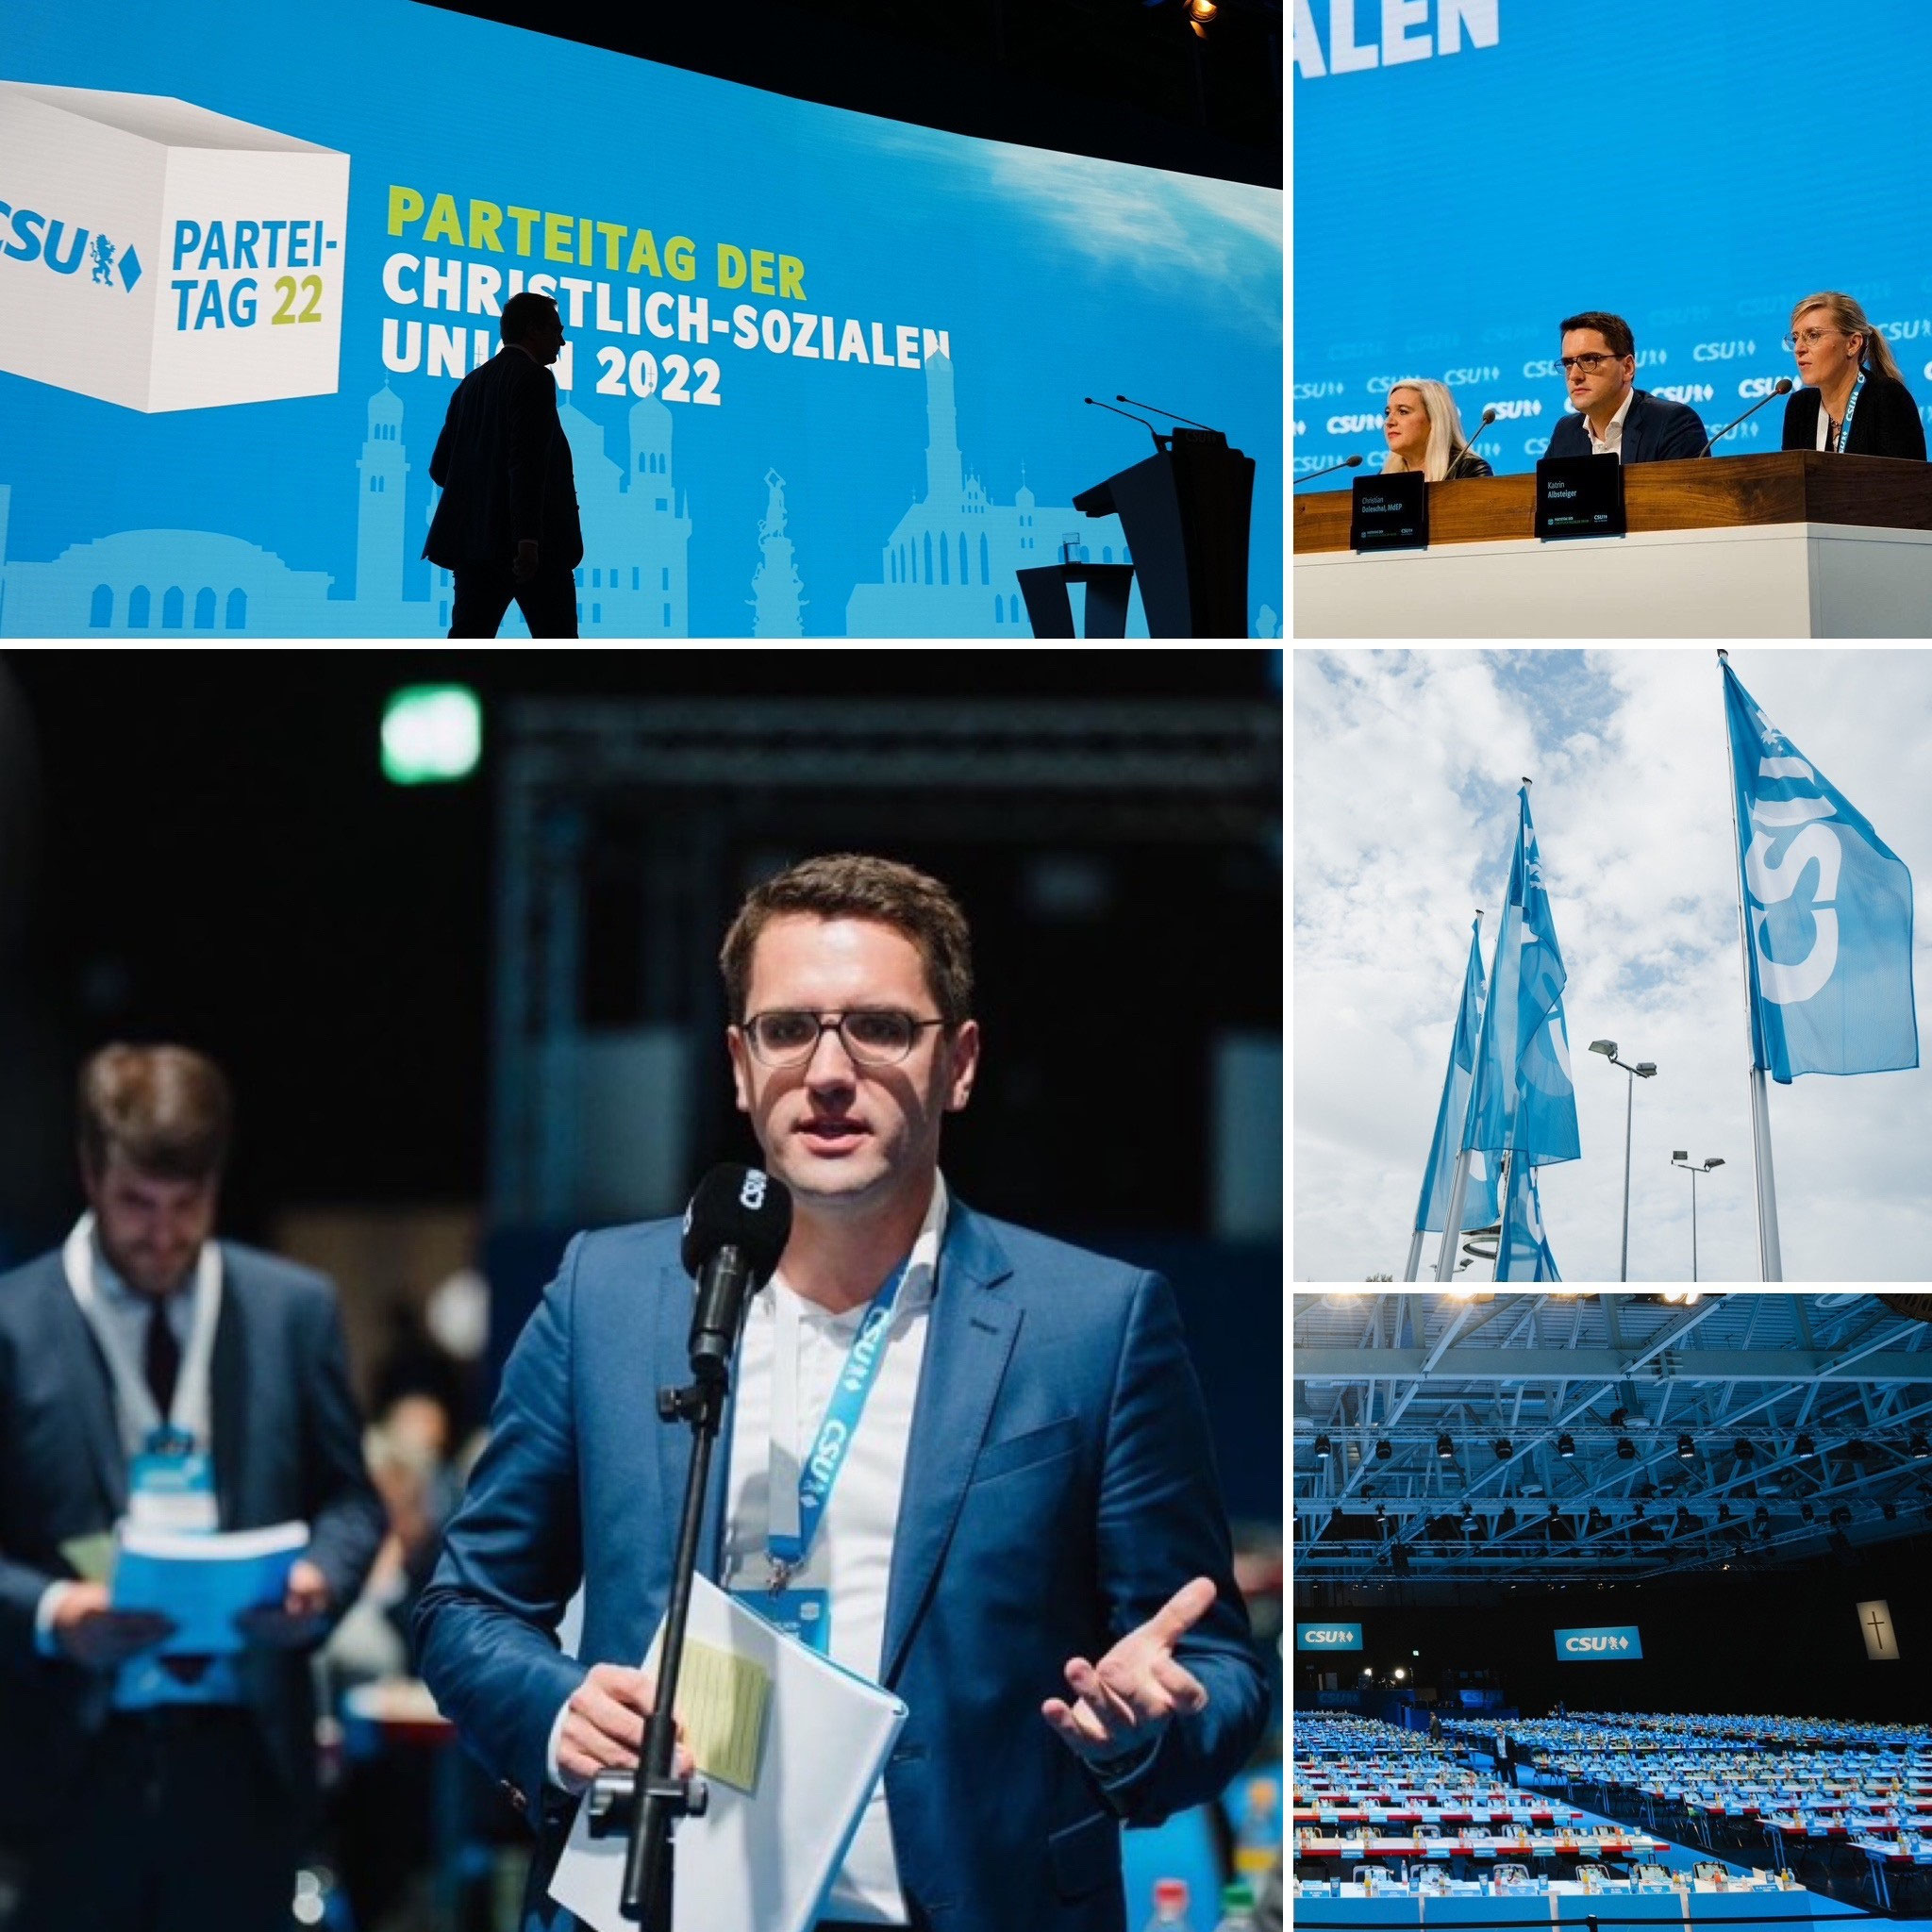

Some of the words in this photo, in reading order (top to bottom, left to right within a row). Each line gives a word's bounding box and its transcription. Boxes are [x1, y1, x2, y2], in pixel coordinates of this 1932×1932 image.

[172, 220, 338, 271] PARTEI-
[388, 184, 695, 282] PARTEITAG
[717, 242, 807, 301] DER
[172, 278, 258, 331] TAG
[271, 274, 323, 325] 22
[1693, 341, 1735, 361] CSU
[382, 317, 574, 391] UNIN
[595, 345, 722, 407] 2022
[1443, 367, 1482, 386] CSU
[1326, 413, 1365, 435] CSU
[1362, 496, 1383, 505] Christian
[1548, 490, 1576, 498] Albsteiger
[810, 1418, 846, 1484] CSU
[1305, 1630, 1338, 1643] CSU
[1565, 1636, 1607, 1652] CSU
